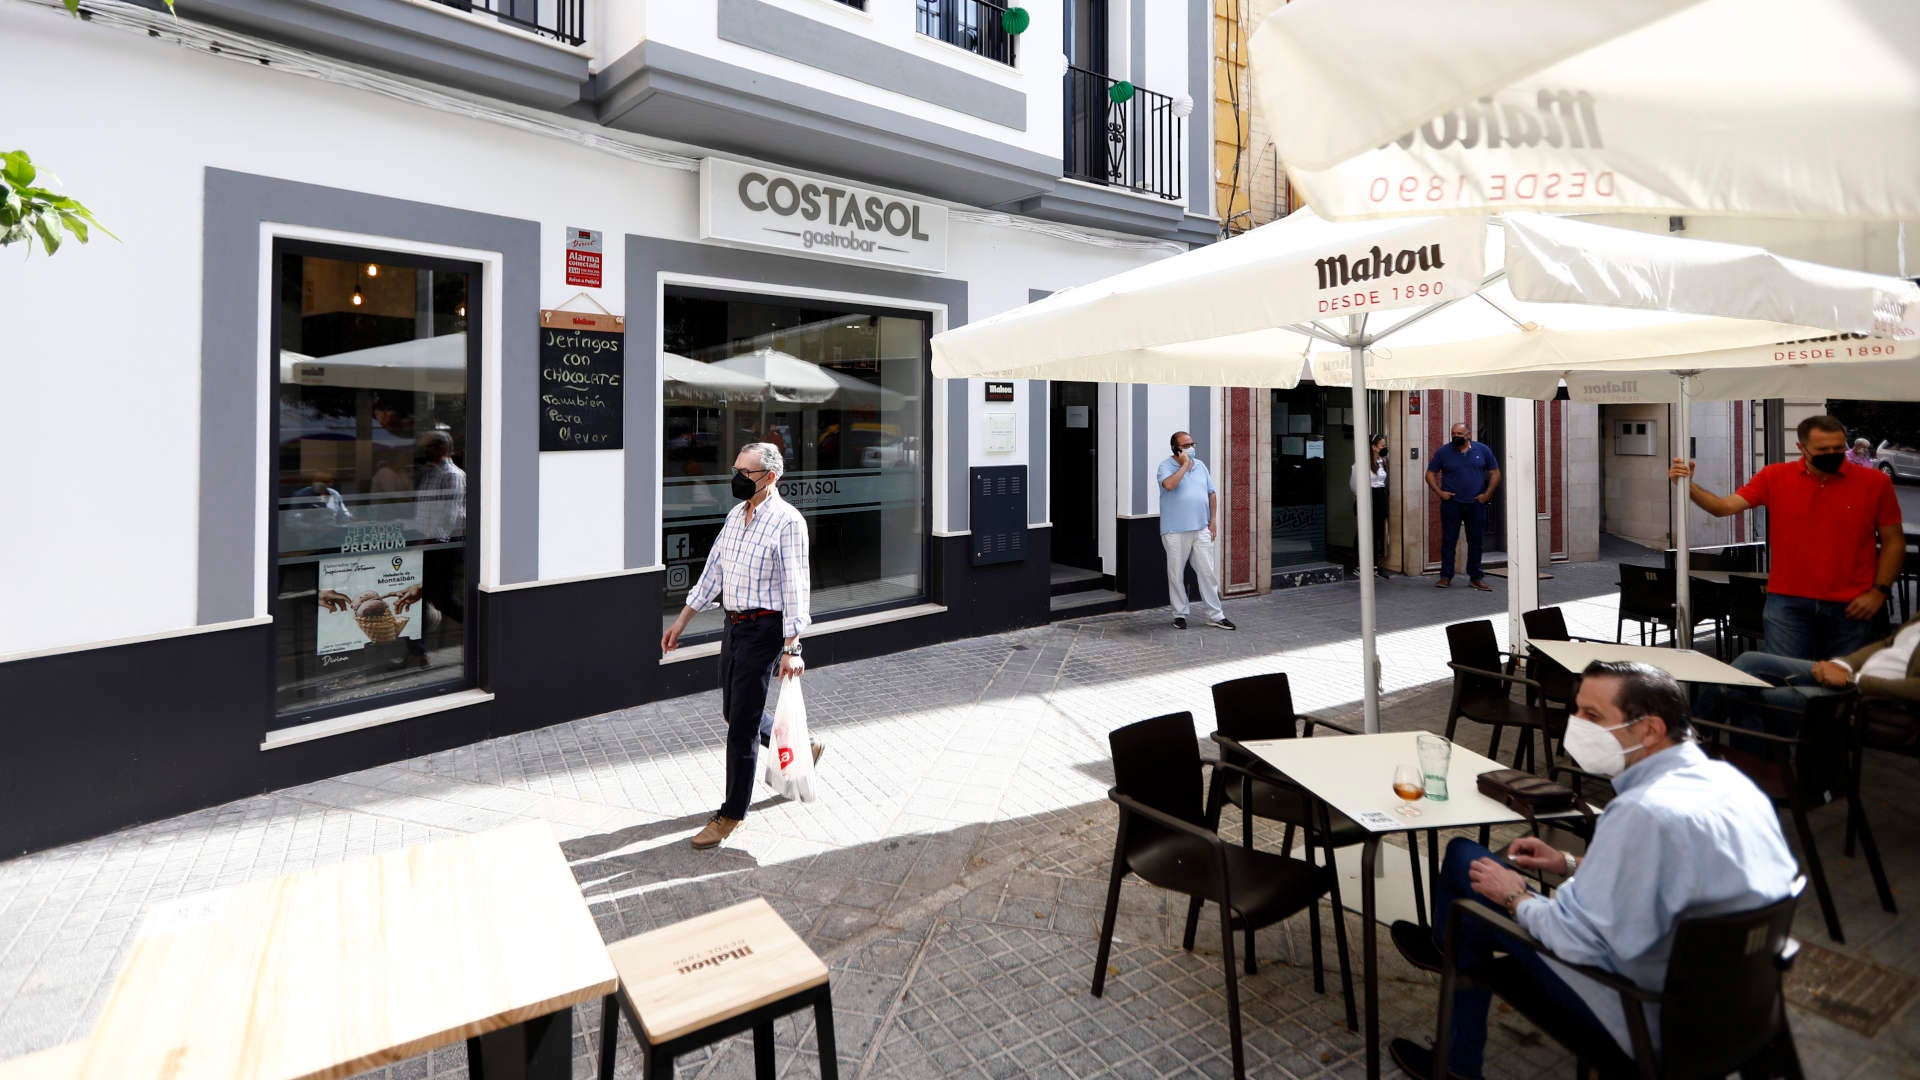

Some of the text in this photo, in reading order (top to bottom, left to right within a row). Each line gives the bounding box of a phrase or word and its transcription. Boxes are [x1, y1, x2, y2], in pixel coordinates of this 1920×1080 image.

[738, 171, 930, 242] COSTASOL
[802, 229, 877, 253] gastrobar
[568, 251, 600, 262] Alarma
[568, 260, 600, 269] conectada
[1314, 243, 1446, 290] Mahou
[1318, 281, 1444, 313] DESDE 1890
[546, 330, 619, 354] Jeringos
[1774, 345, 1896, 361] DESDE 1890
[543, 368, 620, 386] CHOCOLATE
[775, 480, 841, 497] OSTASOL
[341, 540, 406, 554] PREMIUM
